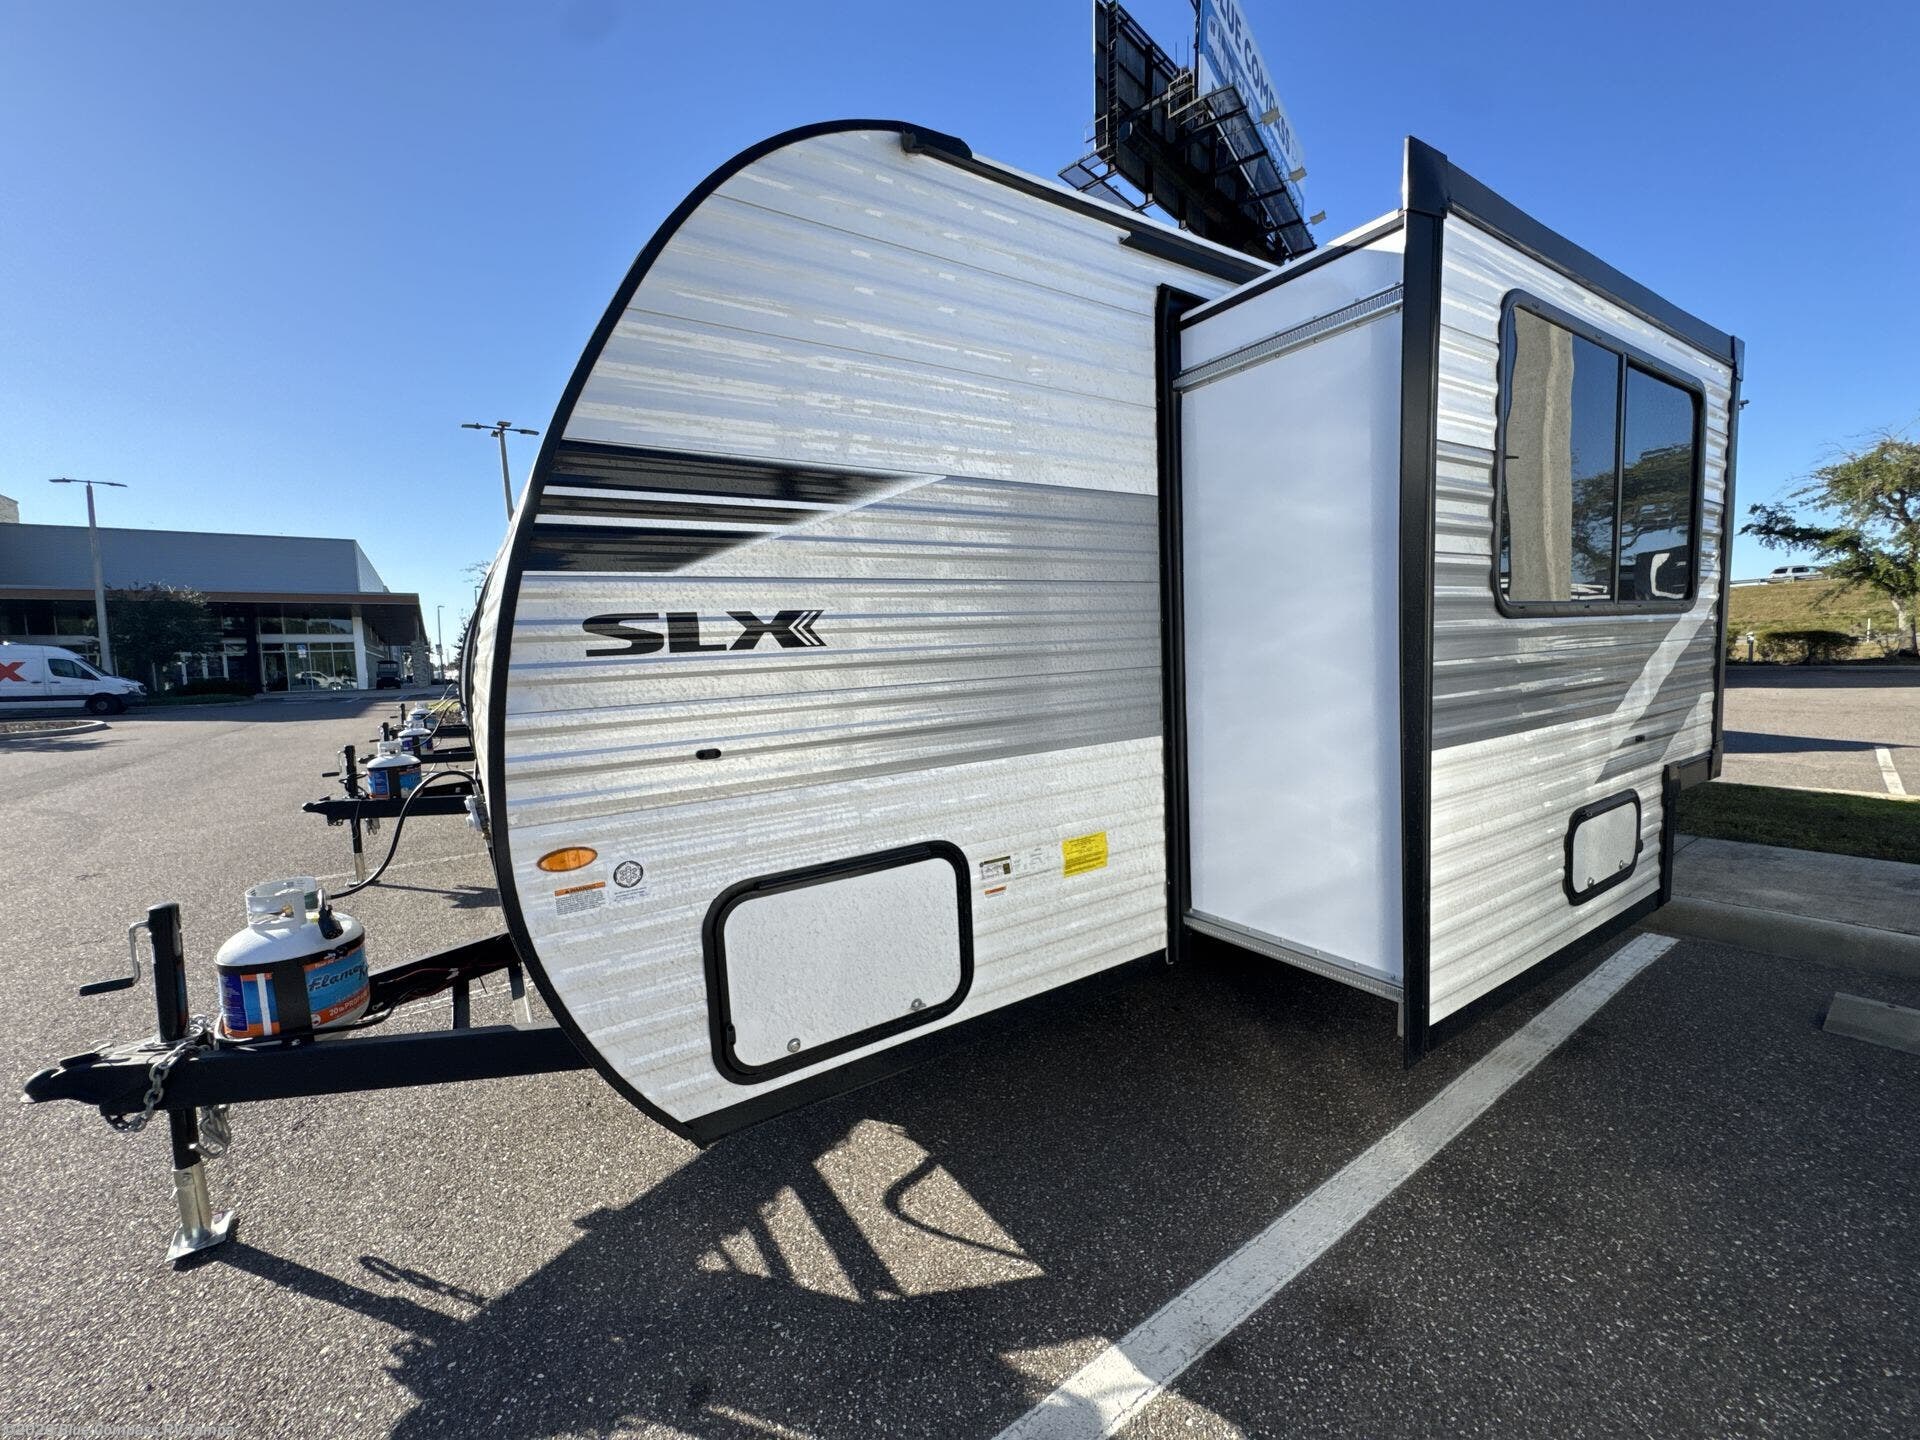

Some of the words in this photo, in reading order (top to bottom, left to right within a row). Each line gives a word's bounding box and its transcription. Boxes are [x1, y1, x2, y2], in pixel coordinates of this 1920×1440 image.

[582, 609, 827, 657] SLX
[308, 965, 361, 991] Flame
[328, 1007, 339, 1017] 20
